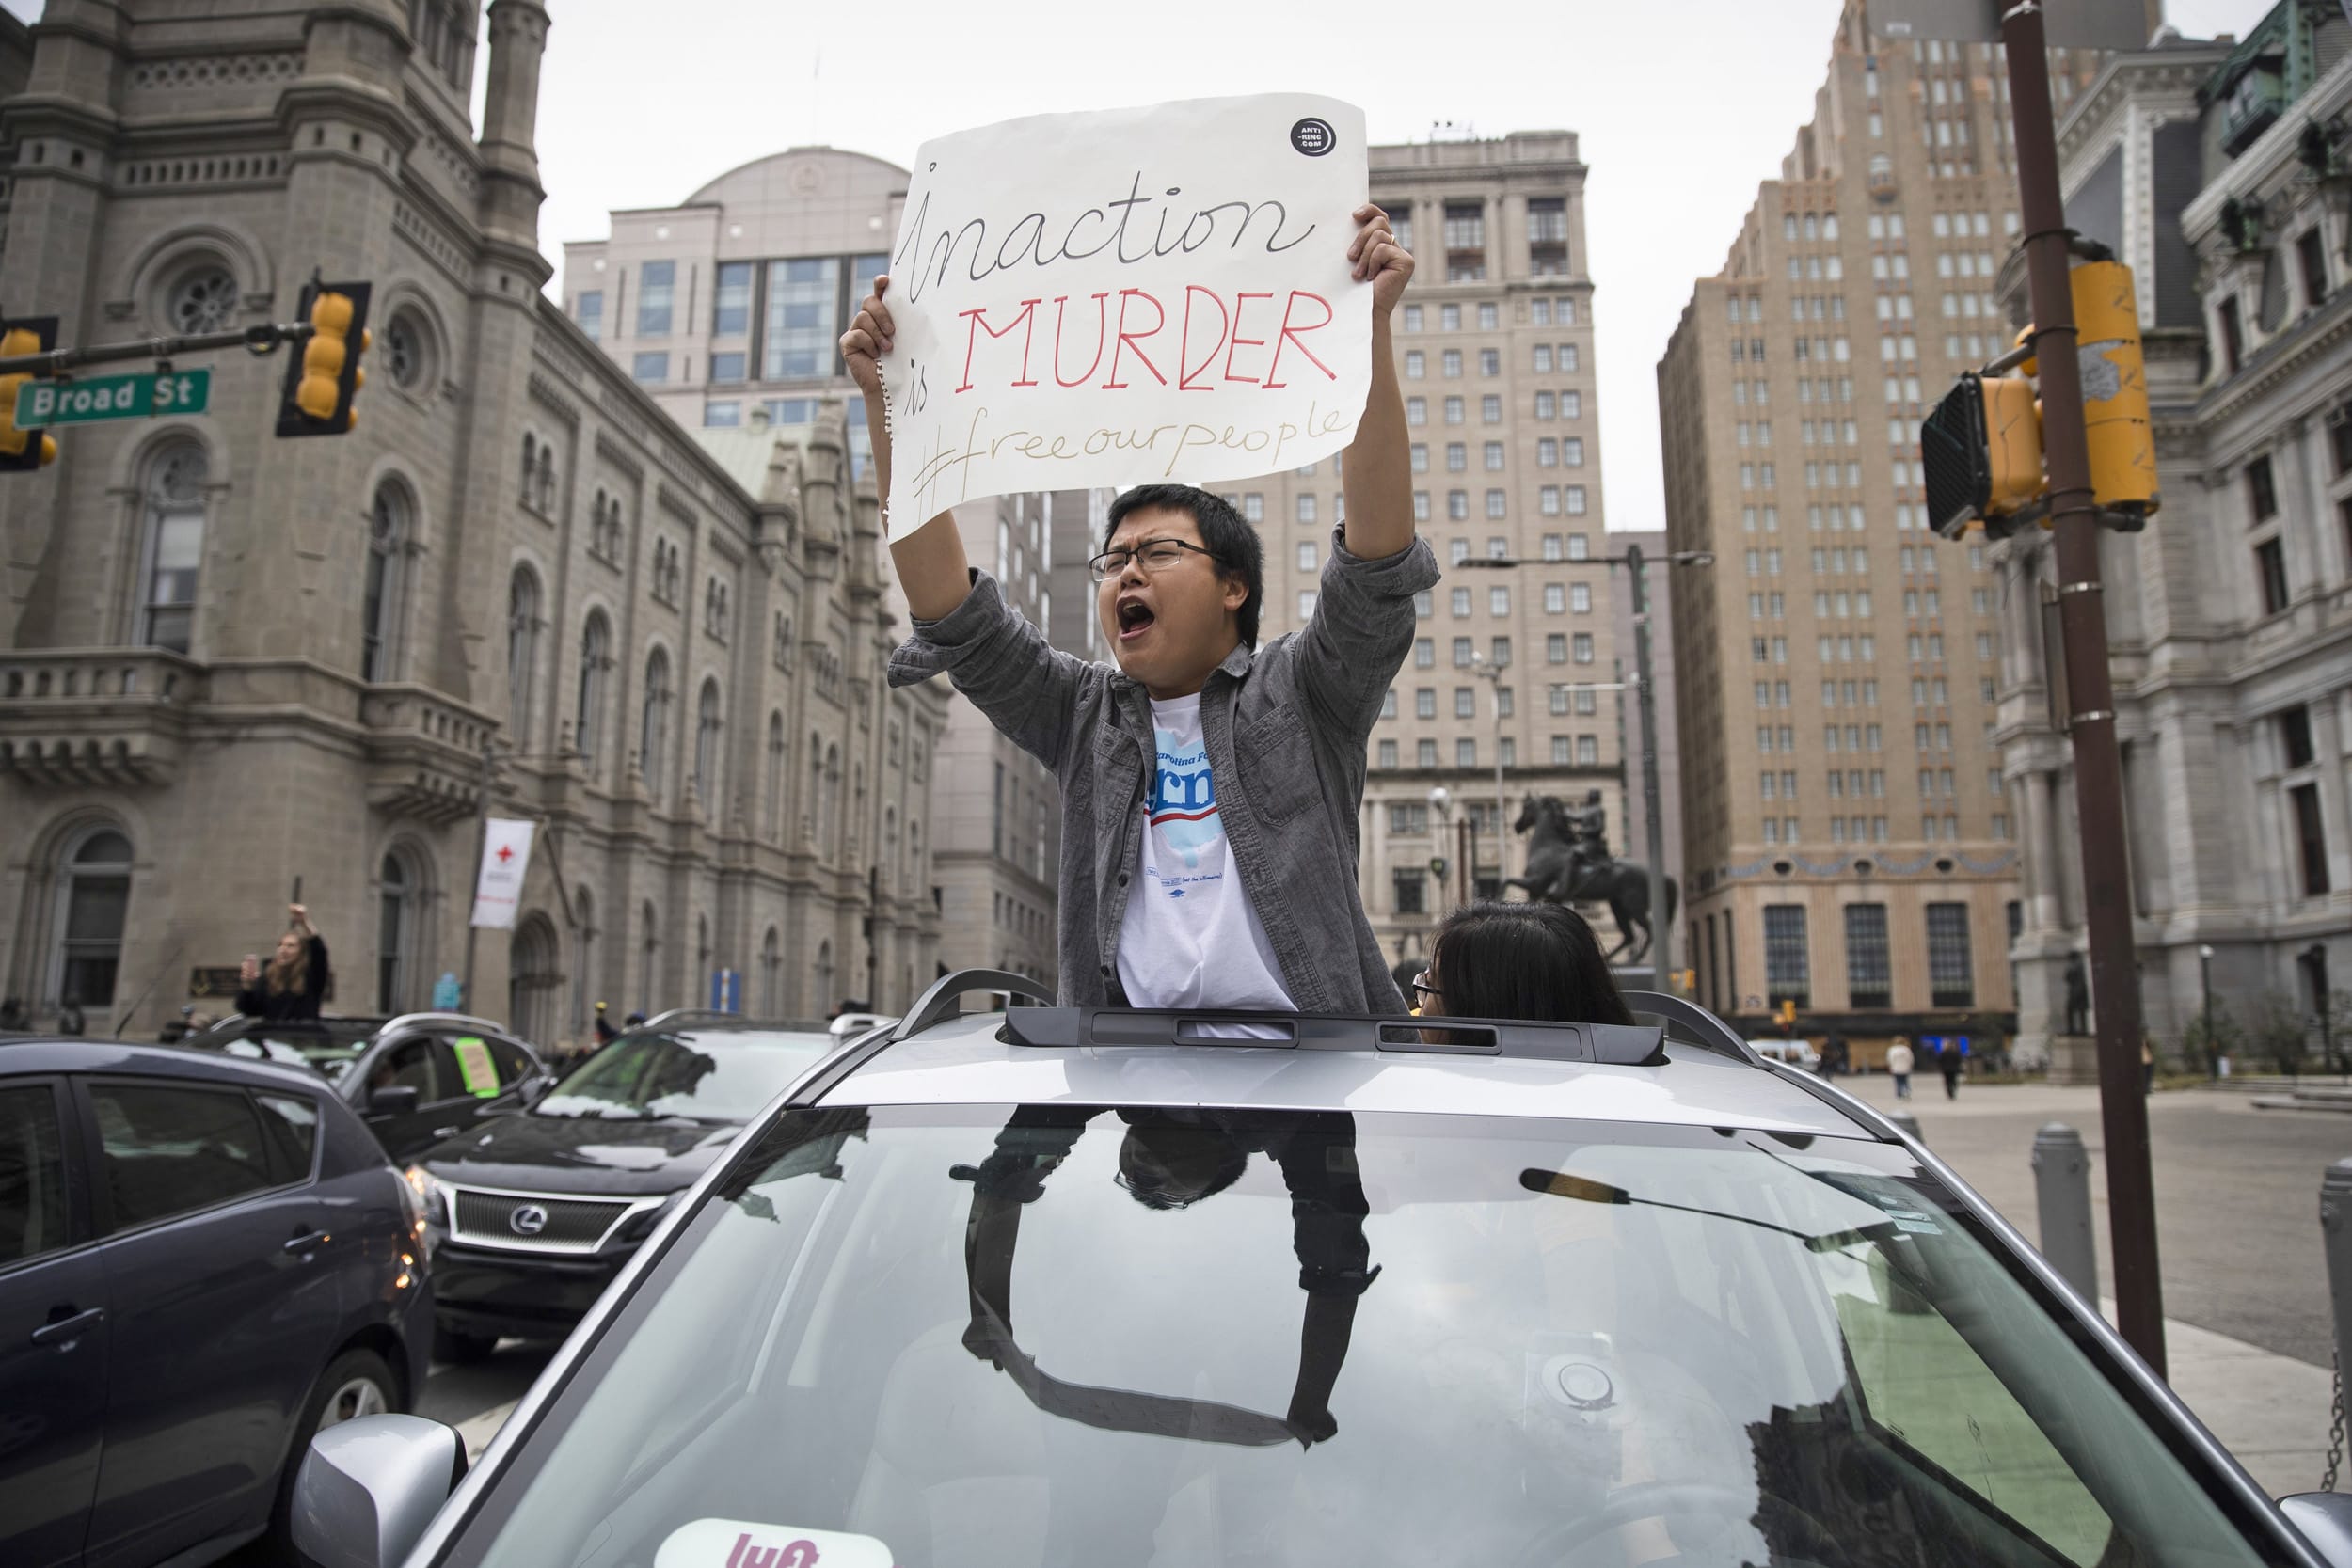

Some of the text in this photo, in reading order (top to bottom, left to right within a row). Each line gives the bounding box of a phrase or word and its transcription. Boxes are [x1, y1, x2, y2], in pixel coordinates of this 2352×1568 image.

[904, 285, 1337, 417] is MURDER
[33, 378, 193, 416] Broad St
